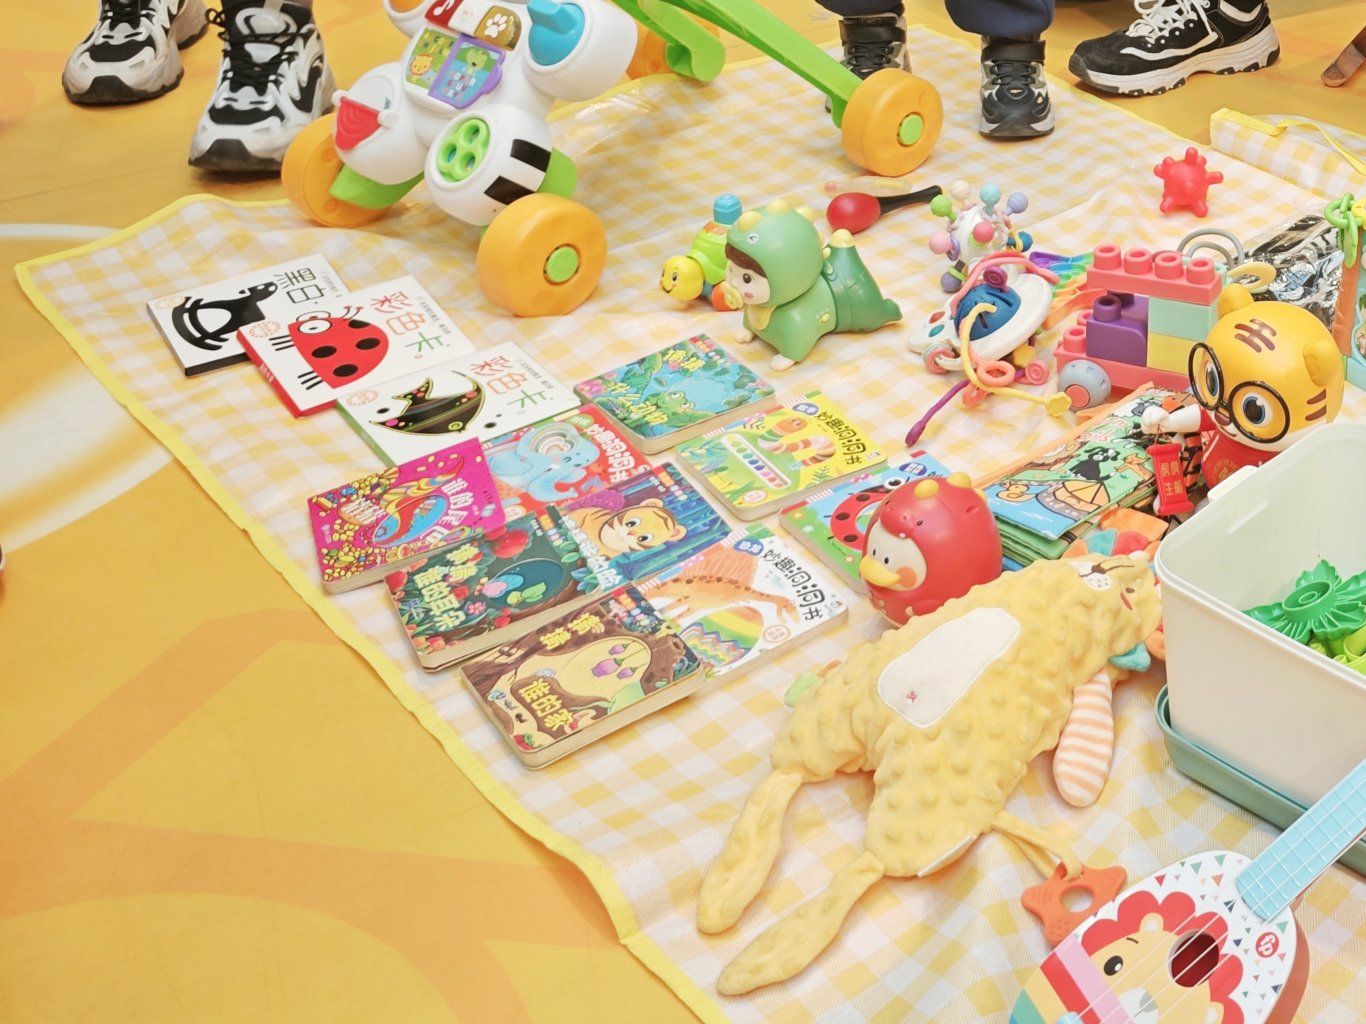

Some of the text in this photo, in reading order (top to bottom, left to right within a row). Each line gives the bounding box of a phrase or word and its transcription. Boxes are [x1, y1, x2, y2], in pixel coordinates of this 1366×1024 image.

[816, 410, 867, 465] 妙趣洞洞书
[412, 564, 466, 632] 谁的耳朵
[760, 548, 828, 621] 妙趣洞洞书
[518, 677, 574, 732] 谁的家
